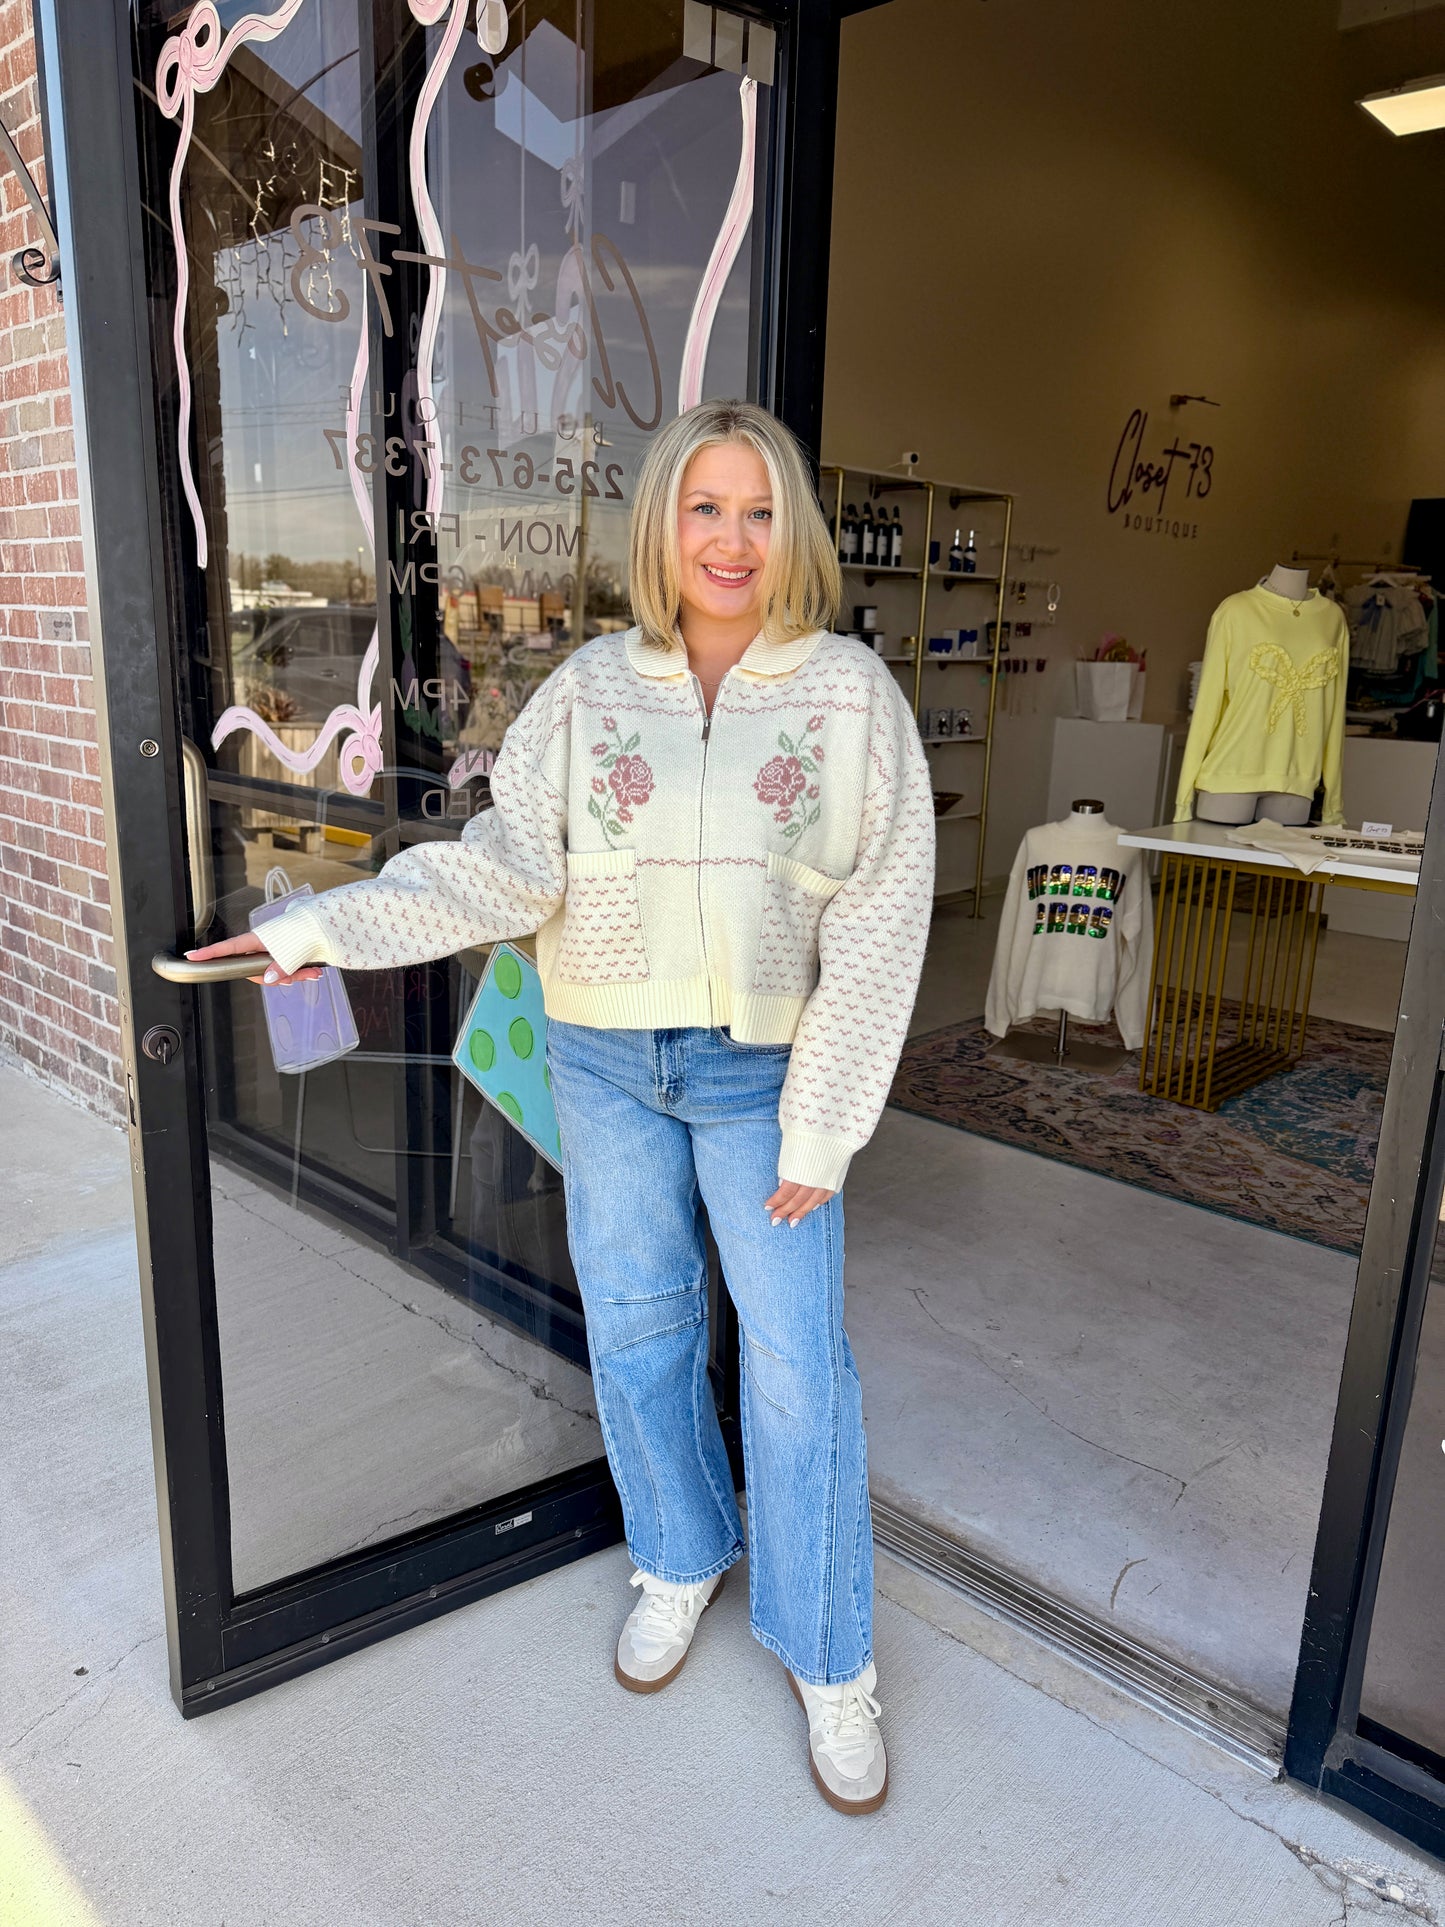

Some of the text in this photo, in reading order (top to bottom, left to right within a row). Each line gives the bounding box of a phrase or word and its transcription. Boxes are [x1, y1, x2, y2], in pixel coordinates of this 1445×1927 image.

[1107, 408, 1214, 515] Closet 73
[1124, 513, 1198, 539] BOUTIQUE
